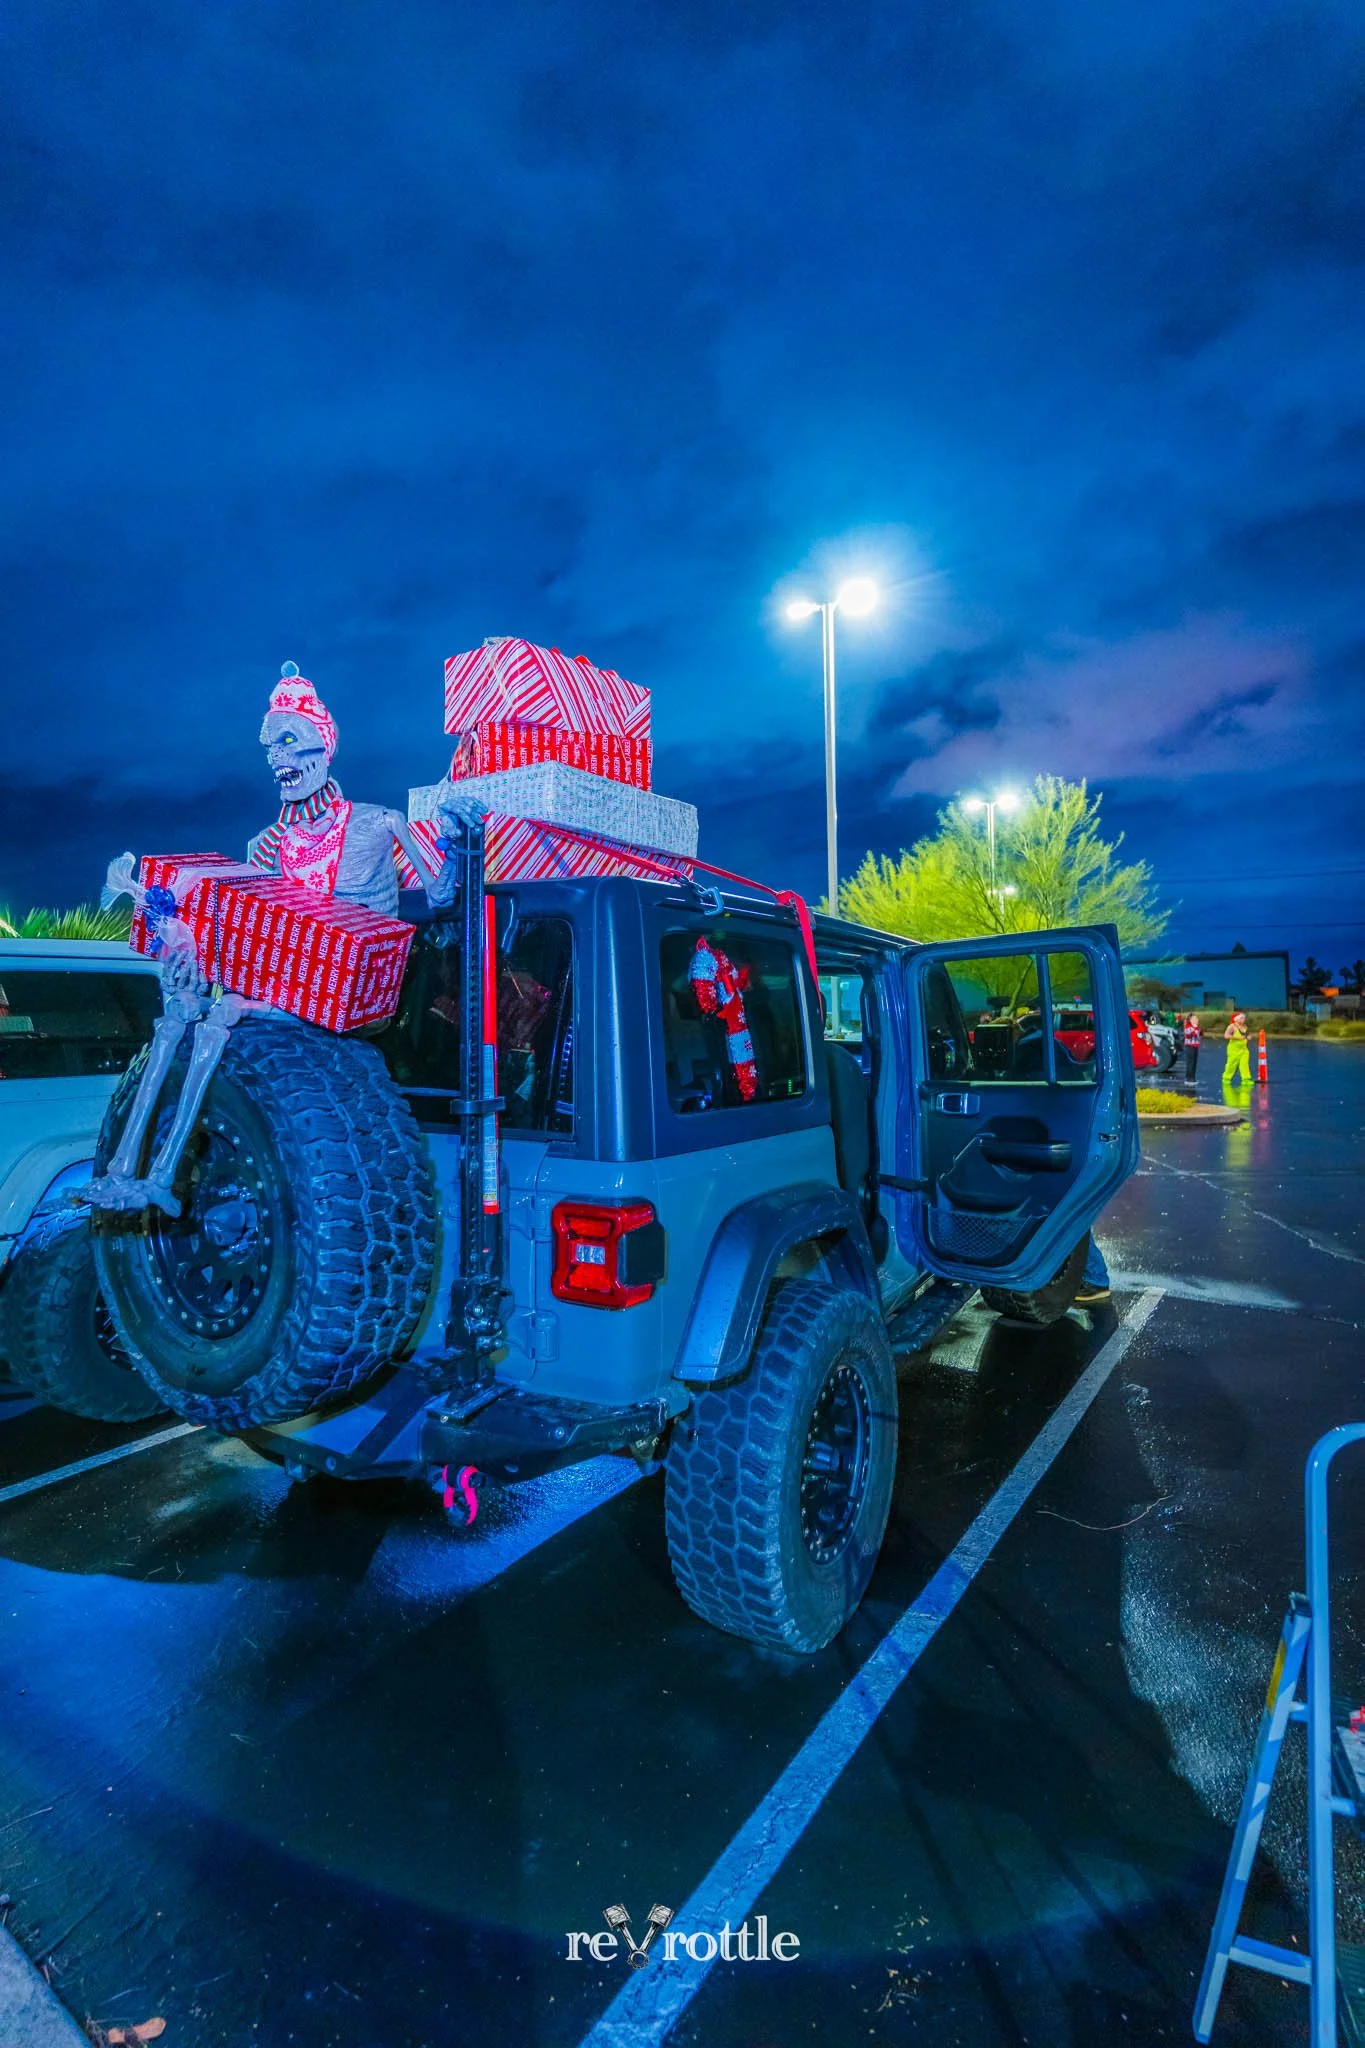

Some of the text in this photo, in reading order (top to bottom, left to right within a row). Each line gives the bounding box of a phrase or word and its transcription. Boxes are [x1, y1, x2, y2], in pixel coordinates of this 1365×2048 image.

[482, 721, 490, 743] MERRY
[495, 744, 503, 766] MERRY
[199, 921, 211, 957] Christmas
[225, 931, 238, 966] Christmas
[232, 900, 245, 929] MERRY
[236, 900, 259, 992] hristmas MERRY Christmas
[253, 942, 267, 976] Christmas
[260, 911, 273, 939] MERRY
[262, 910, 288, 1003] hristmas MERRY Christmas
[280, 952, 296, 987] Christmas
[288, 922, 301, 950] MERRY
[302, 920, 317, 956] Christmas
[332, 931, 347, 967] Christmas
[298, 955, 311, 984] MERRY
[310, 963, 325, 998] Christmas
[318, 933, 331, 961] MERRY
[327, 966, 340, 995] MERRY
[338, 974, 354, 1009] Christmas
[347, 942, 360, 971] MERRY
